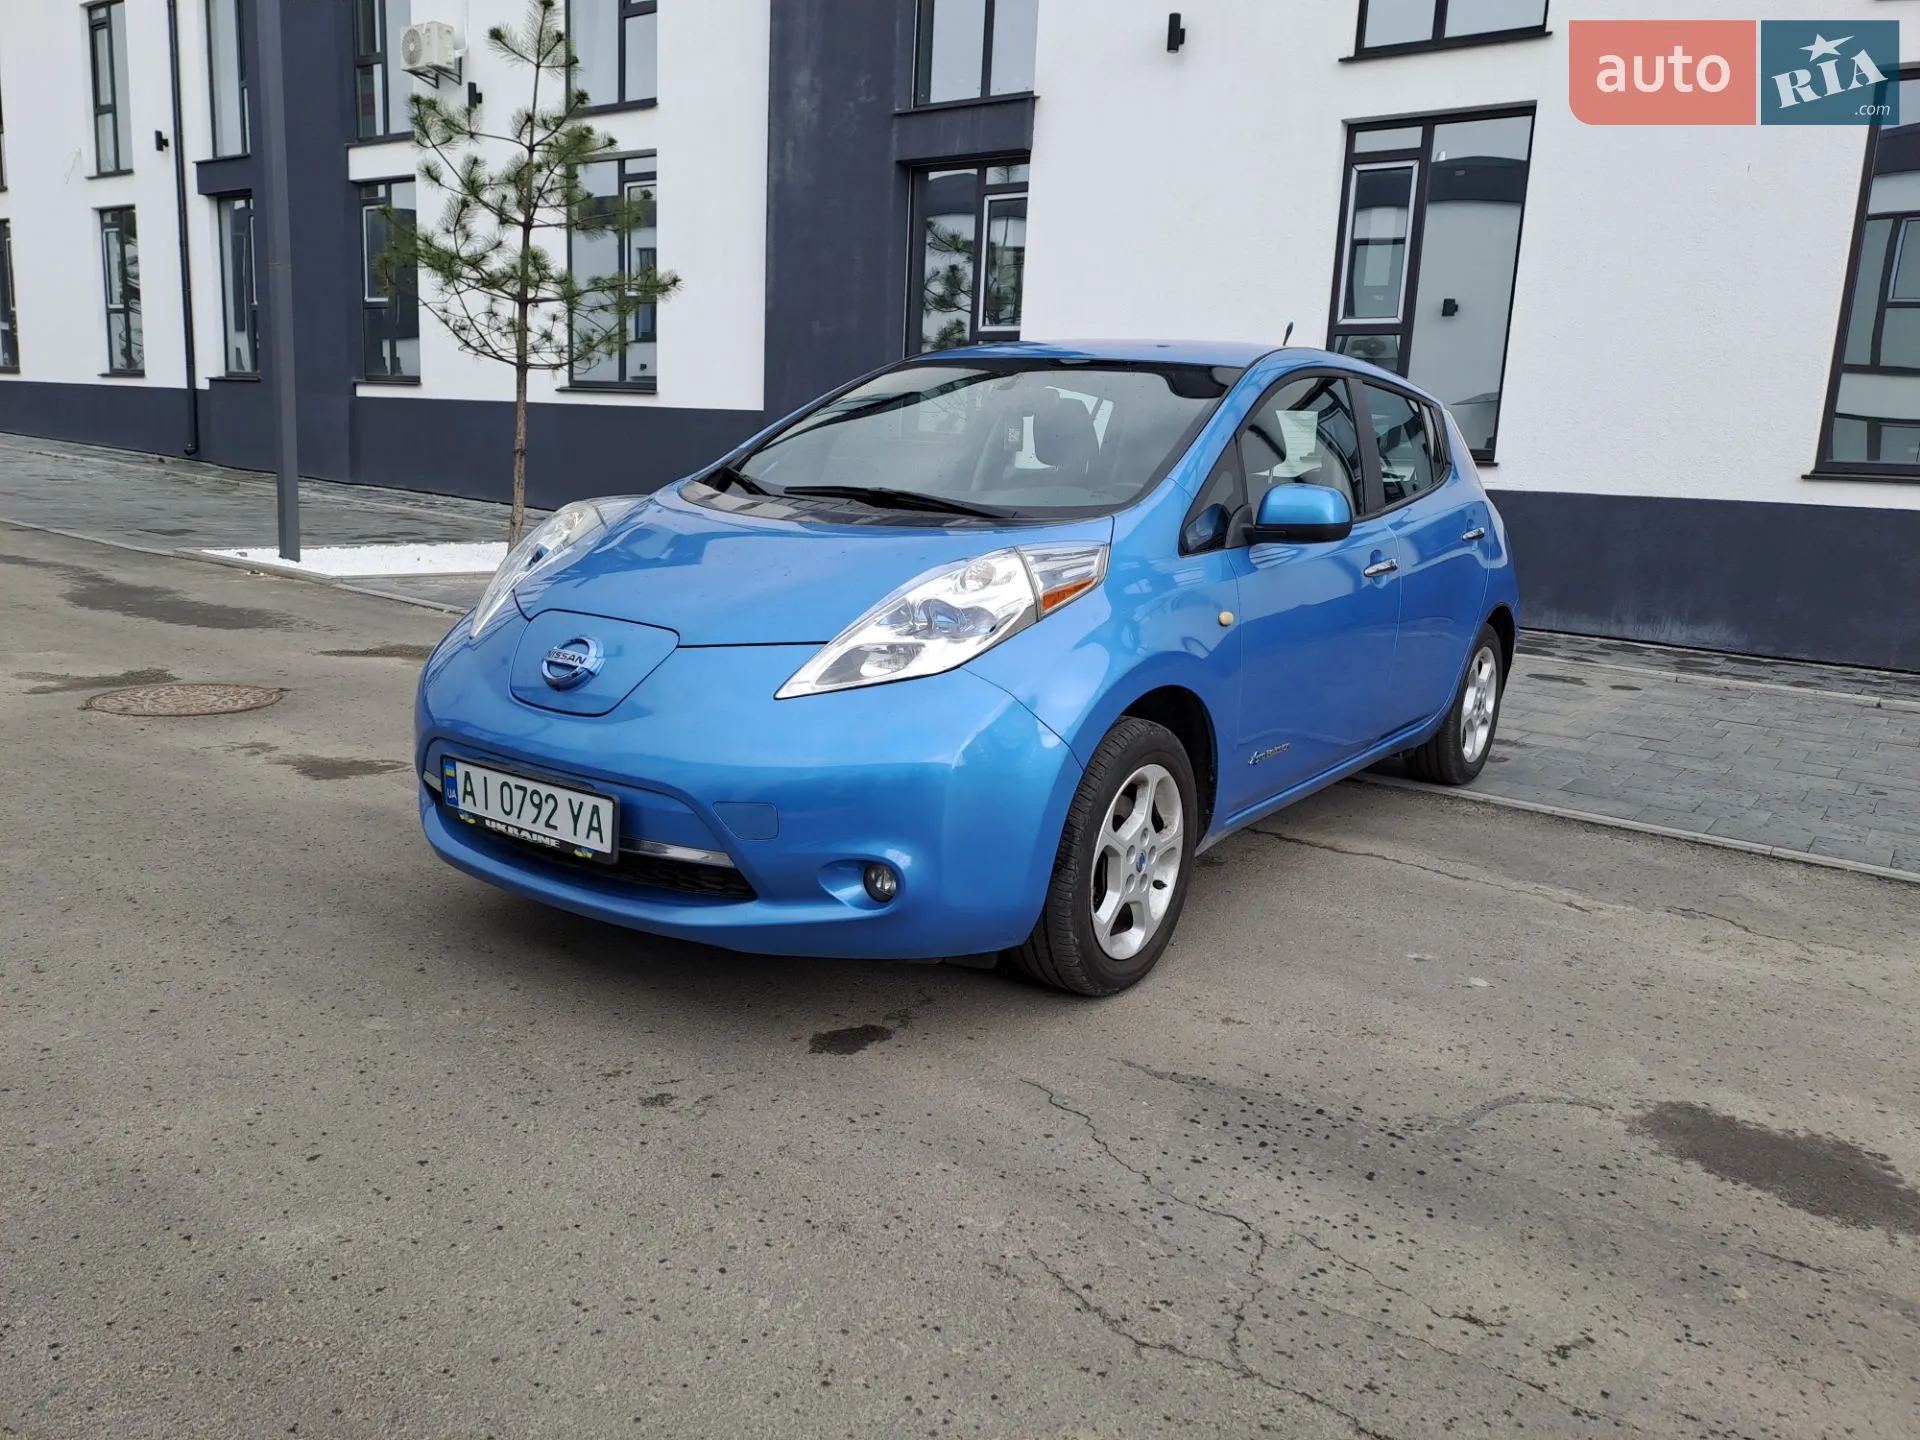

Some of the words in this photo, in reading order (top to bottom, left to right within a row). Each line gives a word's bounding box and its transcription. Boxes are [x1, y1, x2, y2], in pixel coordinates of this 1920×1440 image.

[546, 649, 587, 665] NISSAN
[462, 770, 489, 811] AI
[500, 781, 559, 831] 0792
[568, 798, 604, 844] YA
[485, 819, 561, 849] UKRAINE
